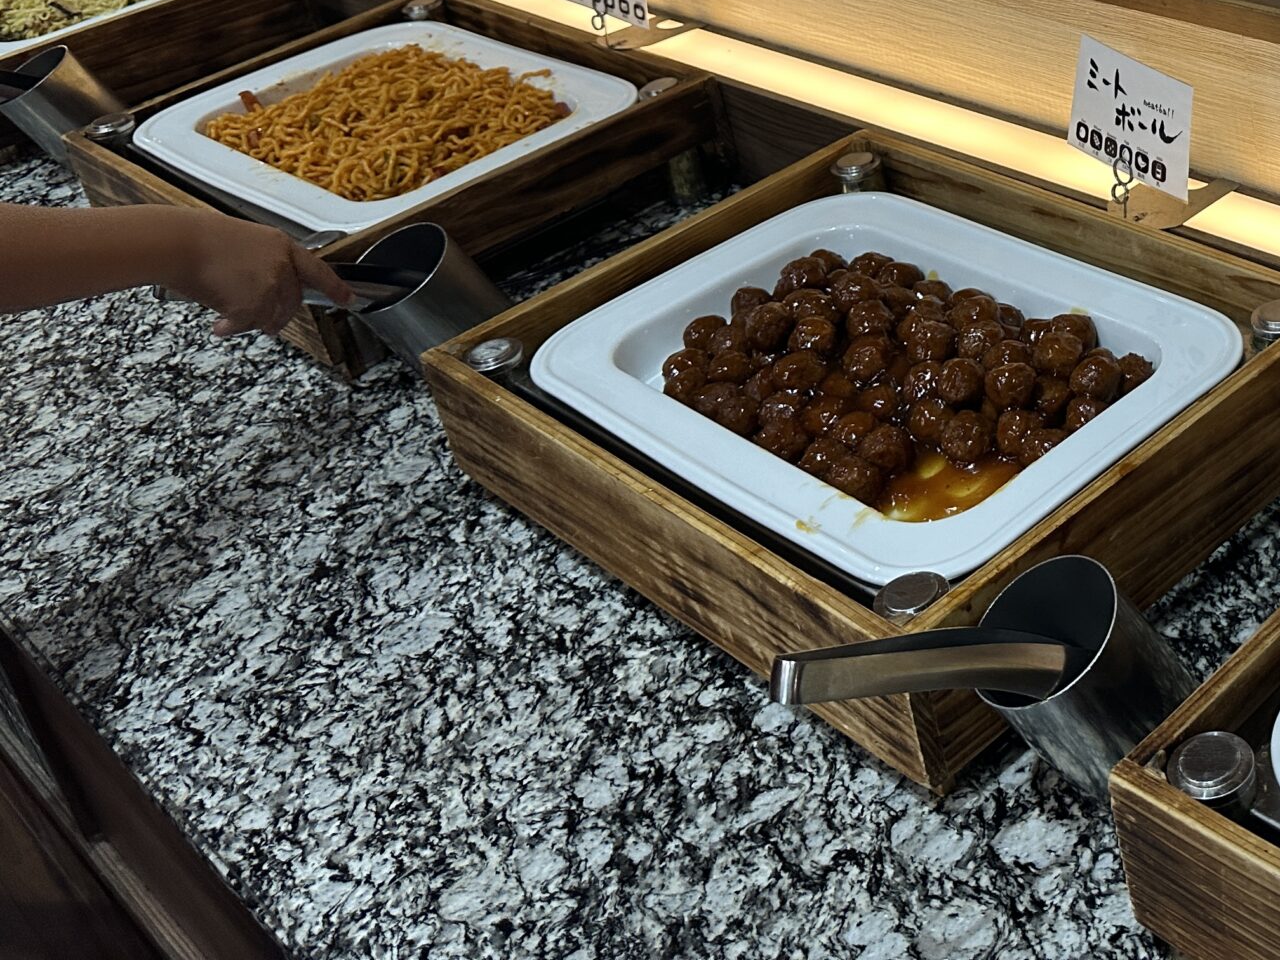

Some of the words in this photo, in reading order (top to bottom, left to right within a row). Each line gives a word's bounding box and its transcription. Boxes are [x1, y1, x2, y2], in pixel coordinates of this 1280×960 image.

[1087, 57, 1128, 99] ミート
[1114, 102, 1183, 144] ボール
